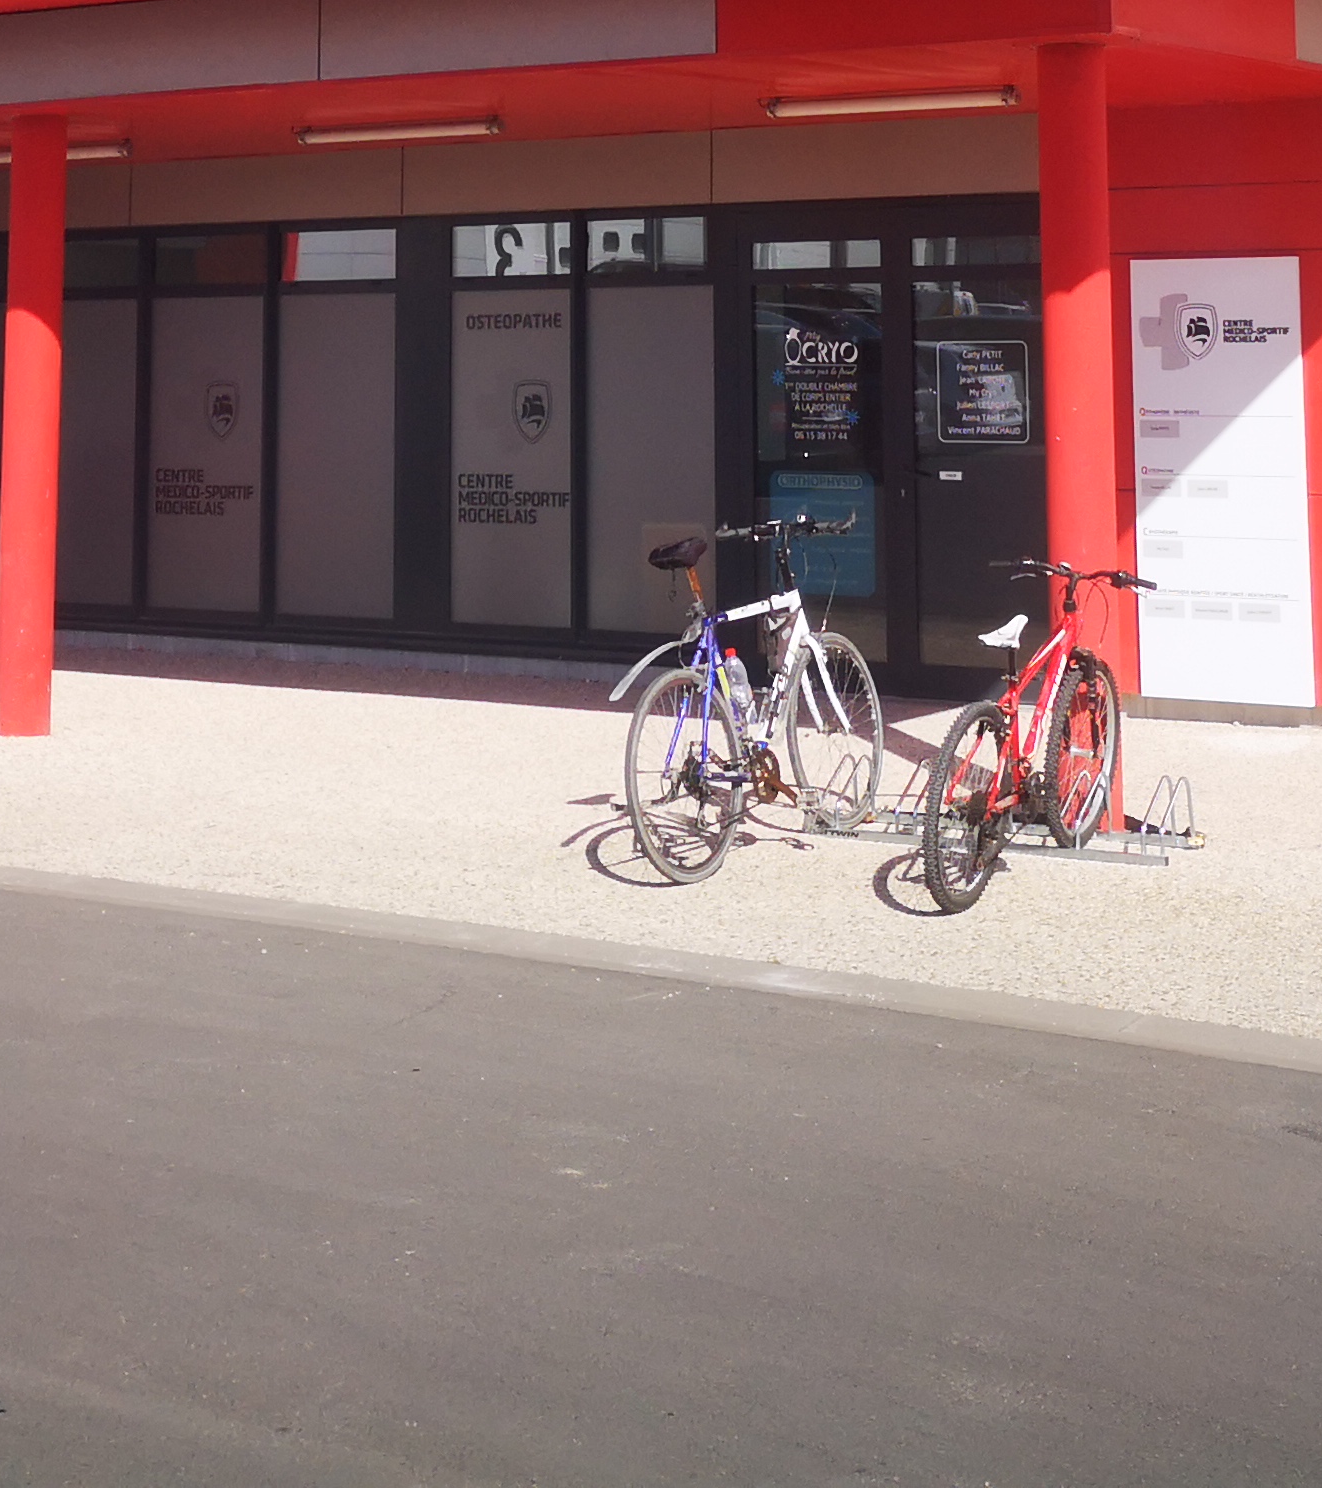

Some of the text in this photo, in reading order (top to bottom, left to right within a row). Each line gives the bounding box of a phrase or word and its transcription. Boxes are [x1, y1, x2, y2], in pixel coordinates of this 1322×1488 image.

[466, 313, 562, 330] OSTEOPATHE
[1223, 327, 1290, 335] MEDICO-SPORTIF
[1223, 335, 1267, 343] ROCHELAIS
[796, 382, 823, 391] DOUBLE
[791, 393, 851, 402] DE CORPS ENTIER
[947, 426, 974, 435] Vincent
[156, 469, 204, 483] CENTRE
[458, 473, 513, 489] CENTRE
[156, 485, 254, 500] MEDICO-SPORTIF
[458, 491, 570, 508] MEDICO-SPORTIF
[156, 500, 225, 516] ROCHELAIS
[458, 508, 537, 524] ROCHELAIS
